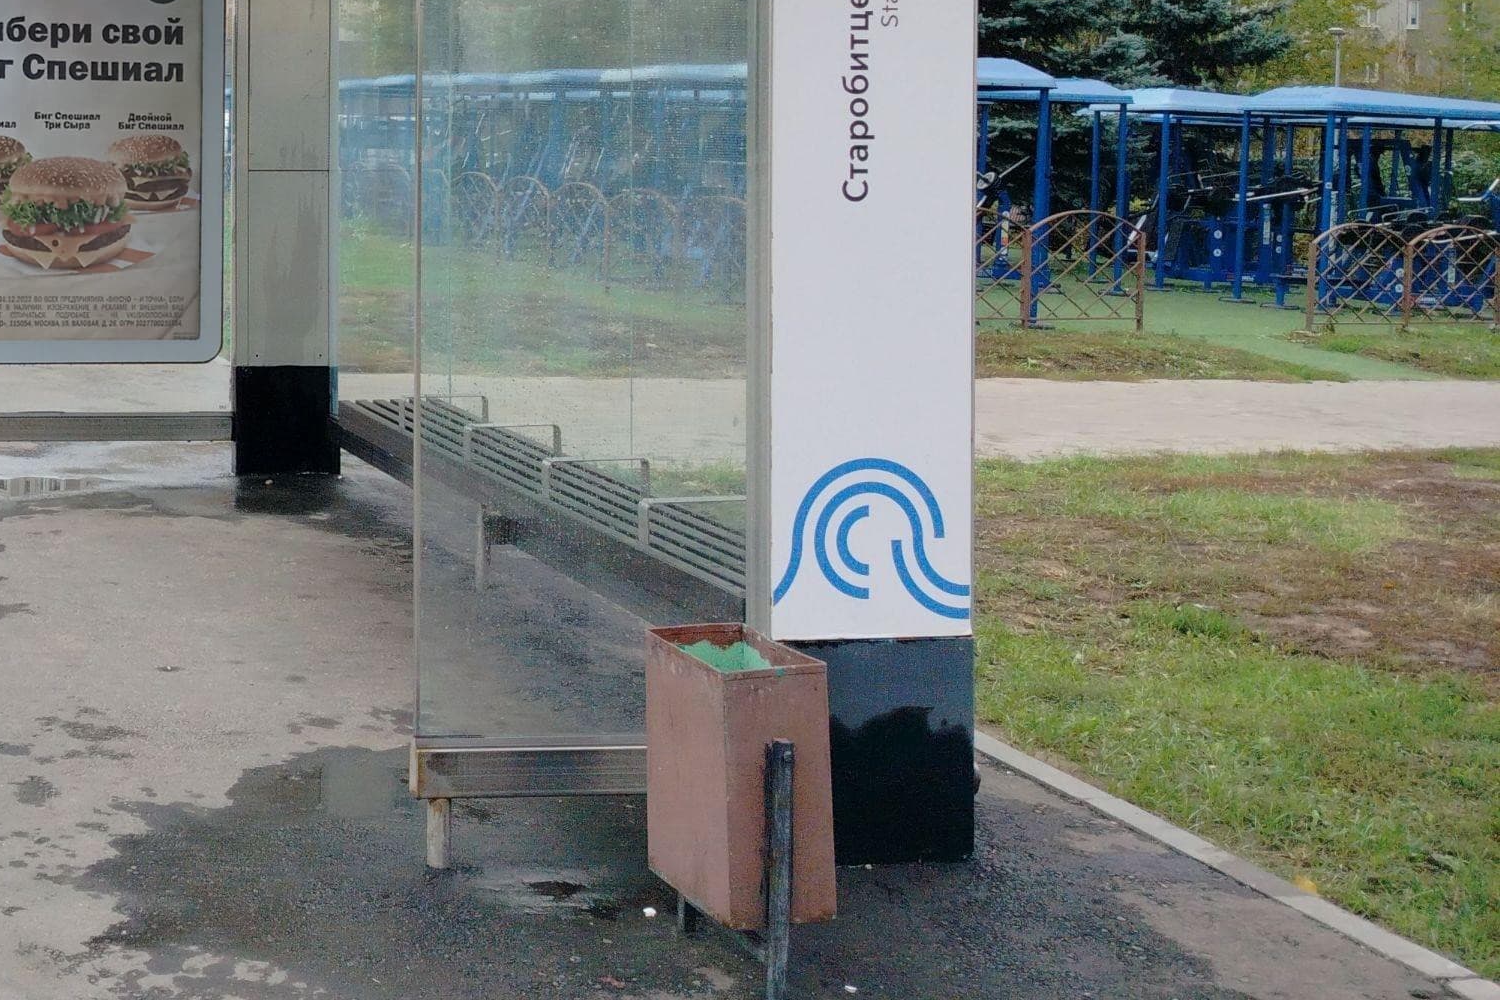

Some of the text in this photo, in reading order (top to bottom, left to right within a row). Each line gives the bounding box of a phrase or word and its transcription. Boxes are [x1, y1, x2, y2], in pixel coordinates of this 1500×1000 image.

[102, 17, 184, 45] свой
[22, 53, 184, 82] Спешиал
[34, 111, 101, 121] Биг Спешиал
[128, 113, 172, 123] Двойной
[44, 121, 90, 131] Три Сыра
[118, 121, 185, 131] Биг Спешиал
